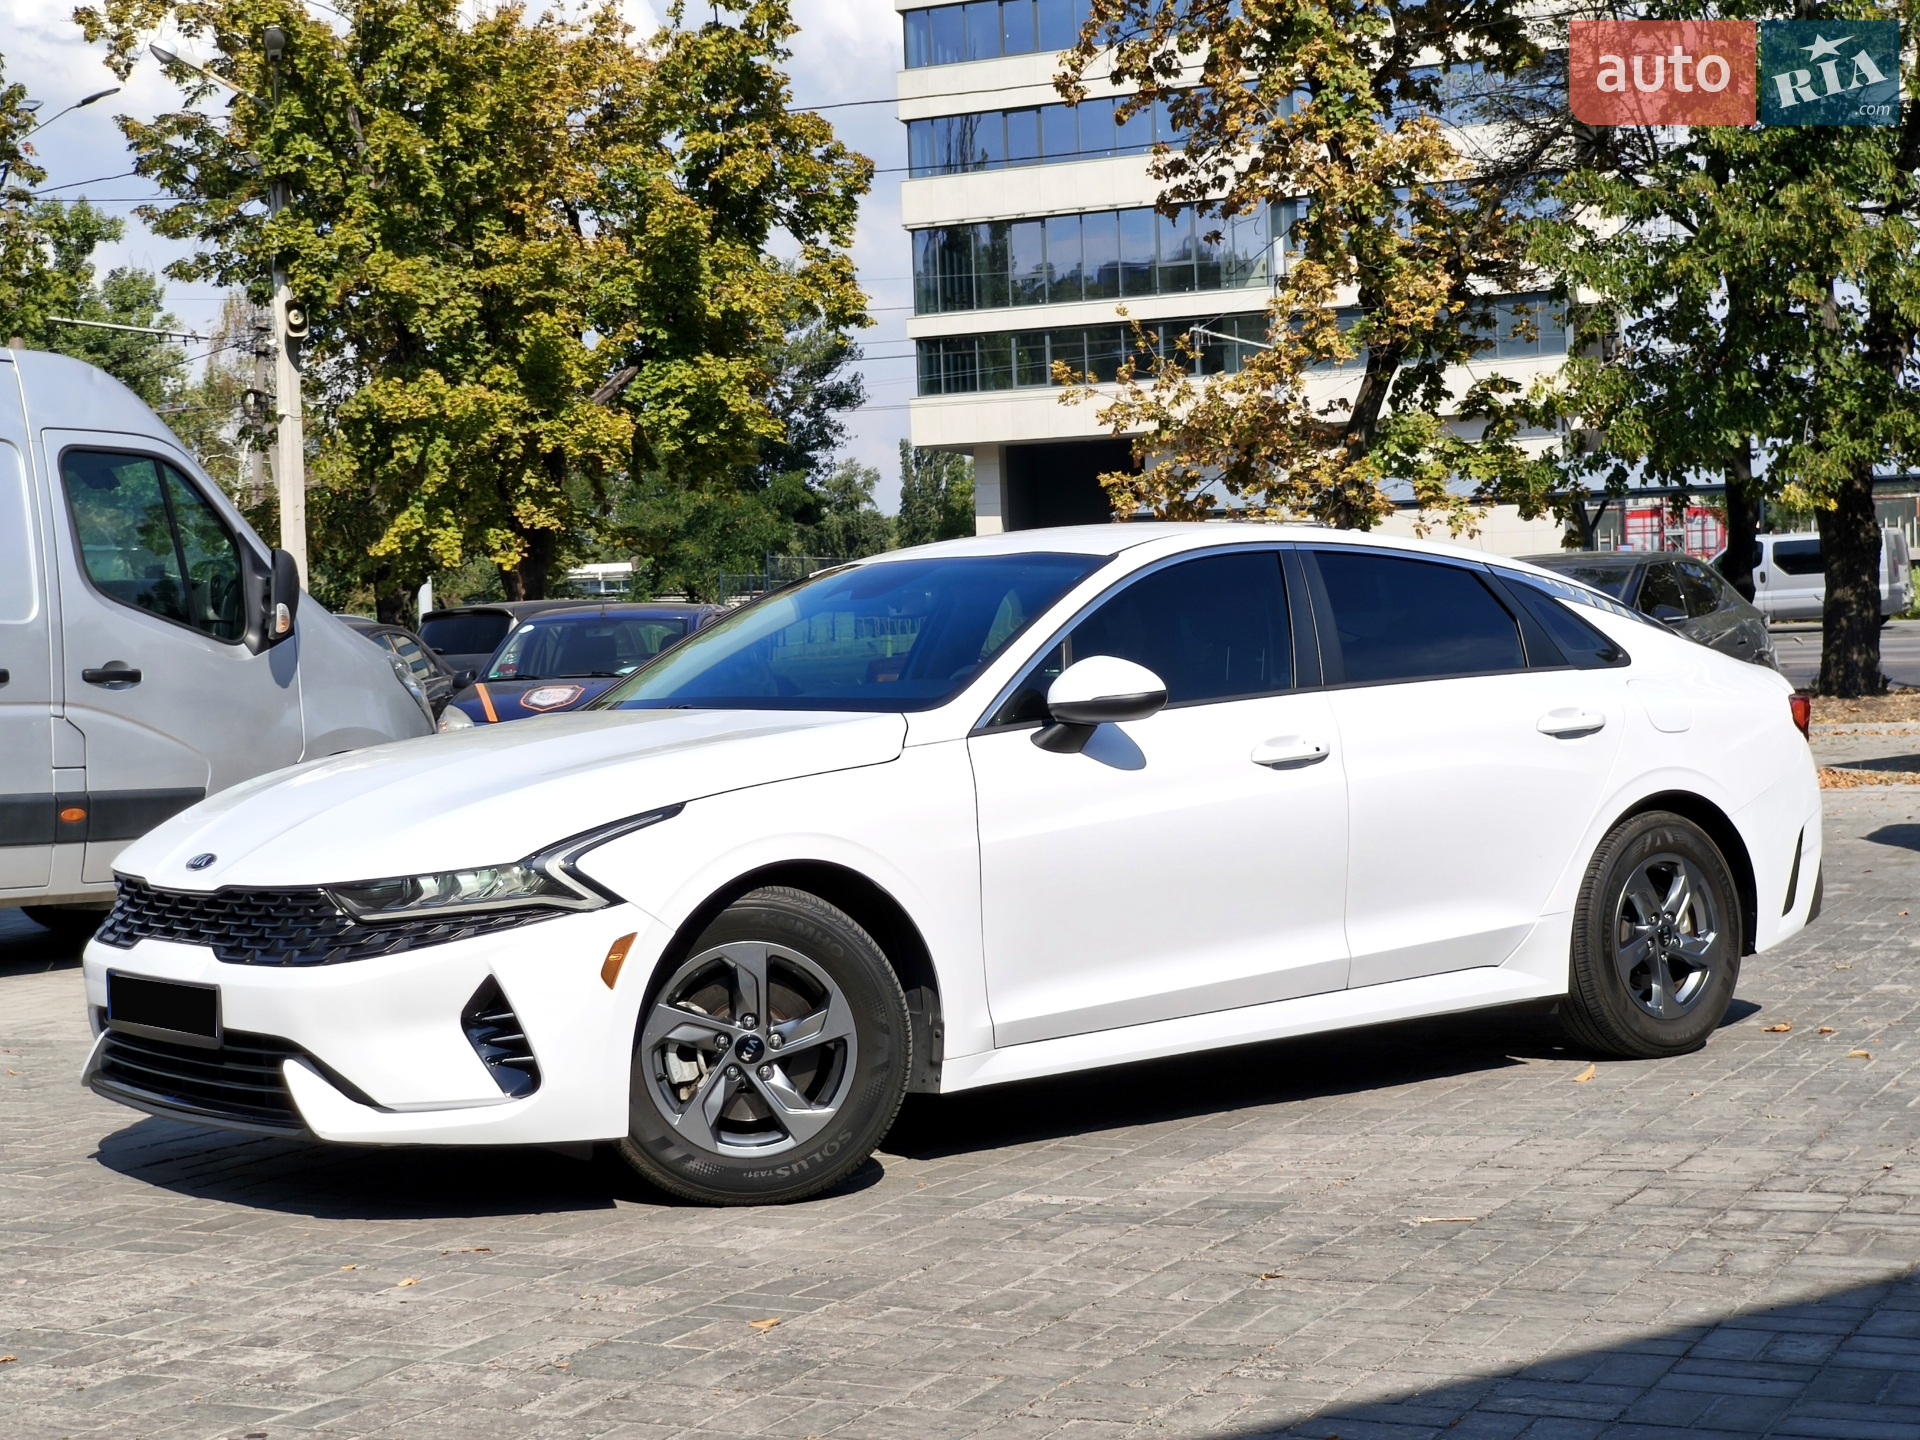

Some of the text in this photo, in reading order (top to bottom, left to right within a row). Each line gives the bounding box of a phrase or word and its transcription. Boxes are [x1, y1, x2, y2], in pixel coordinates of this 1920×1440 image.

[187, 854, 212, 867] KIA
[760, 913, 845, 959] KUMHO
[1662, 925, 1670, 946] KIA
[741, 1039, 759, 1062] KIA
[774, 1128, 853, 1179] SOLUS
